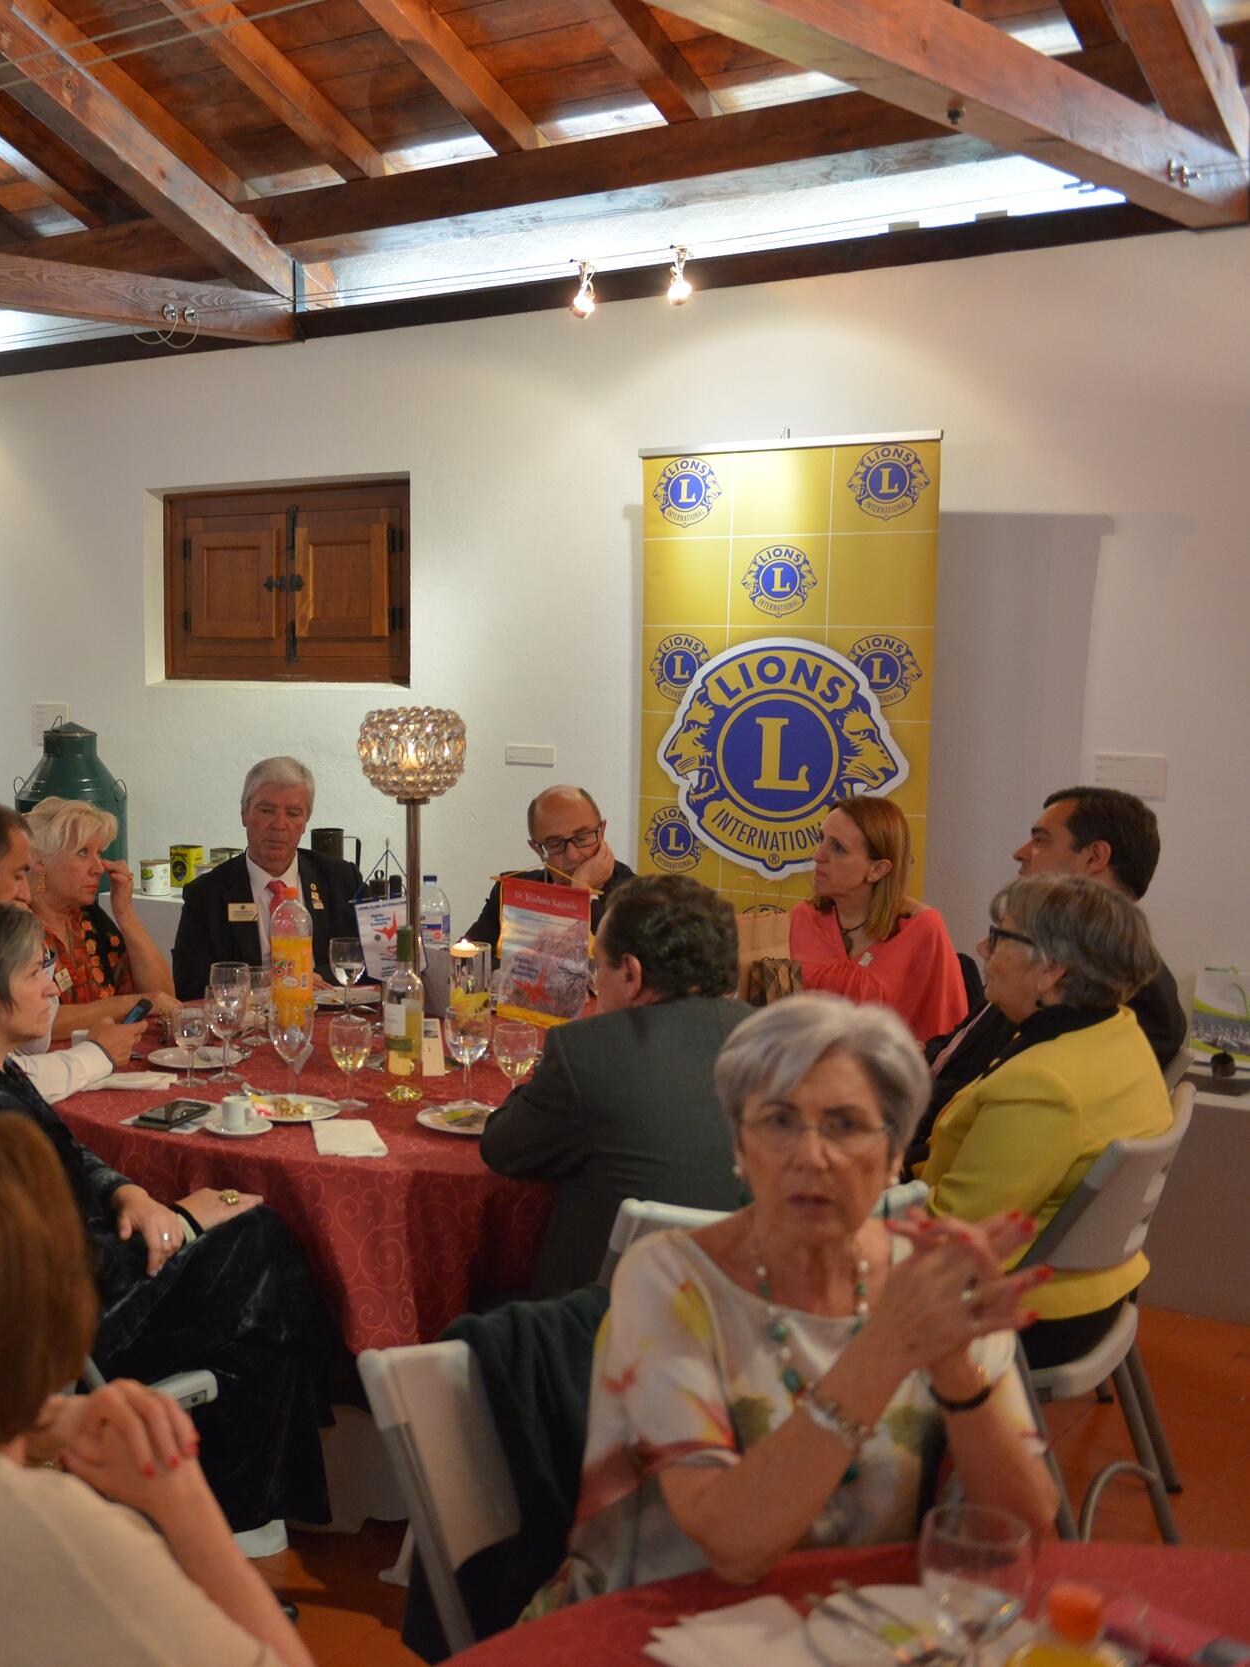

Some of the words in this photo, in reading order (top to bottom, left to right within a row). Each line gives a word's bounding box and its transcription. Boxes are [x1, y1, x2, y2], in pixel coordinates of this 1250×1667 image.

[668, 460, 707, 475] LIONS
[867, 447, 912, 464] LIONS
[678, 479, 697, 503] L
[879, 467, 899, 494] L
[758, 547, 802, 563] LIONS
[771, 567, 791, 592] L
[662, 636, 701, 651] LIONS
[857, 637, 904, 653] LIONS
[672, 655, 690, 679] L
[870, 657, 891, 683] L
[714, 655, 847, 704] LIONS
[753, 717, 810, 792] L
[657, 808, 689, 822] LION
[667, 827, 685, 851] L
[711, 808, 823, 852] INTERNATION
